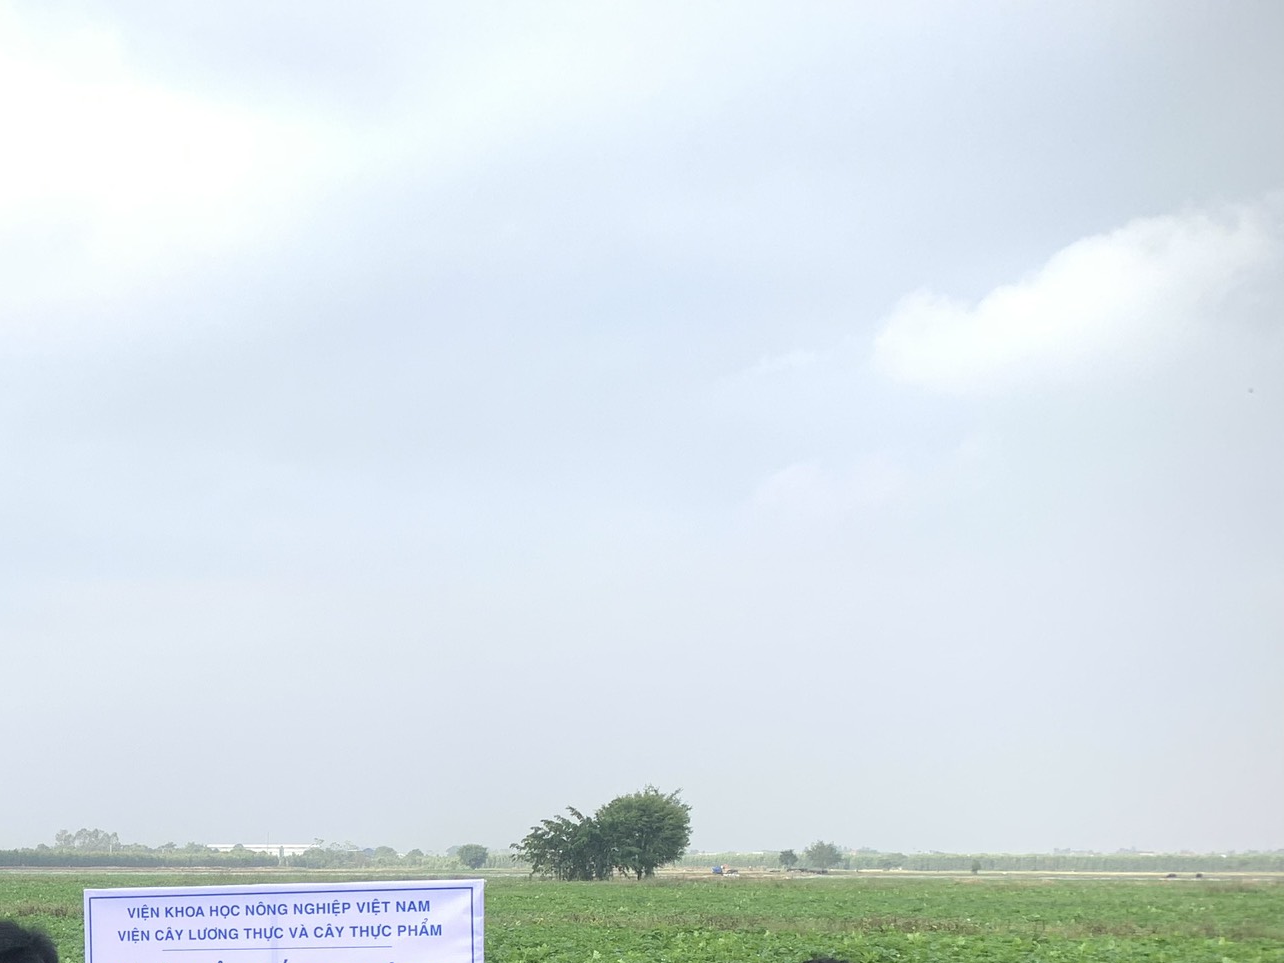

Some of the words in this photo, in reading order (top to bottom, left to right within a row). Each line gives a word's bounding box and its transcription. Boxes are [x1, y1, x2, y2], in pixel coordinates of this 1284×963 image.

[126, 904, 160, 920] VIỆN
[164, 906, 205, 918] KHOA
[209, 905, 241, 919] HỌC
[245, 901, 288, 916] NÔNG
[293, 900, 351, 916] NGHIỆP
[356, 898, 391, 915] VIỆT
[395, 900, 431, 912] NAM
[117, 927, 150, 944] VIỆN
[154, 927, 184, 941] CÂY
[188, 927, 239, 940] LƯƠNG
[242, 926, 284, 941] THỰC
[288, 924, 309, 938] VÀ
[313, 923, 345, 938] CÂY
[348, 924, 392, 939] THỰC
[397, 918, 442, 936] PHẨM
